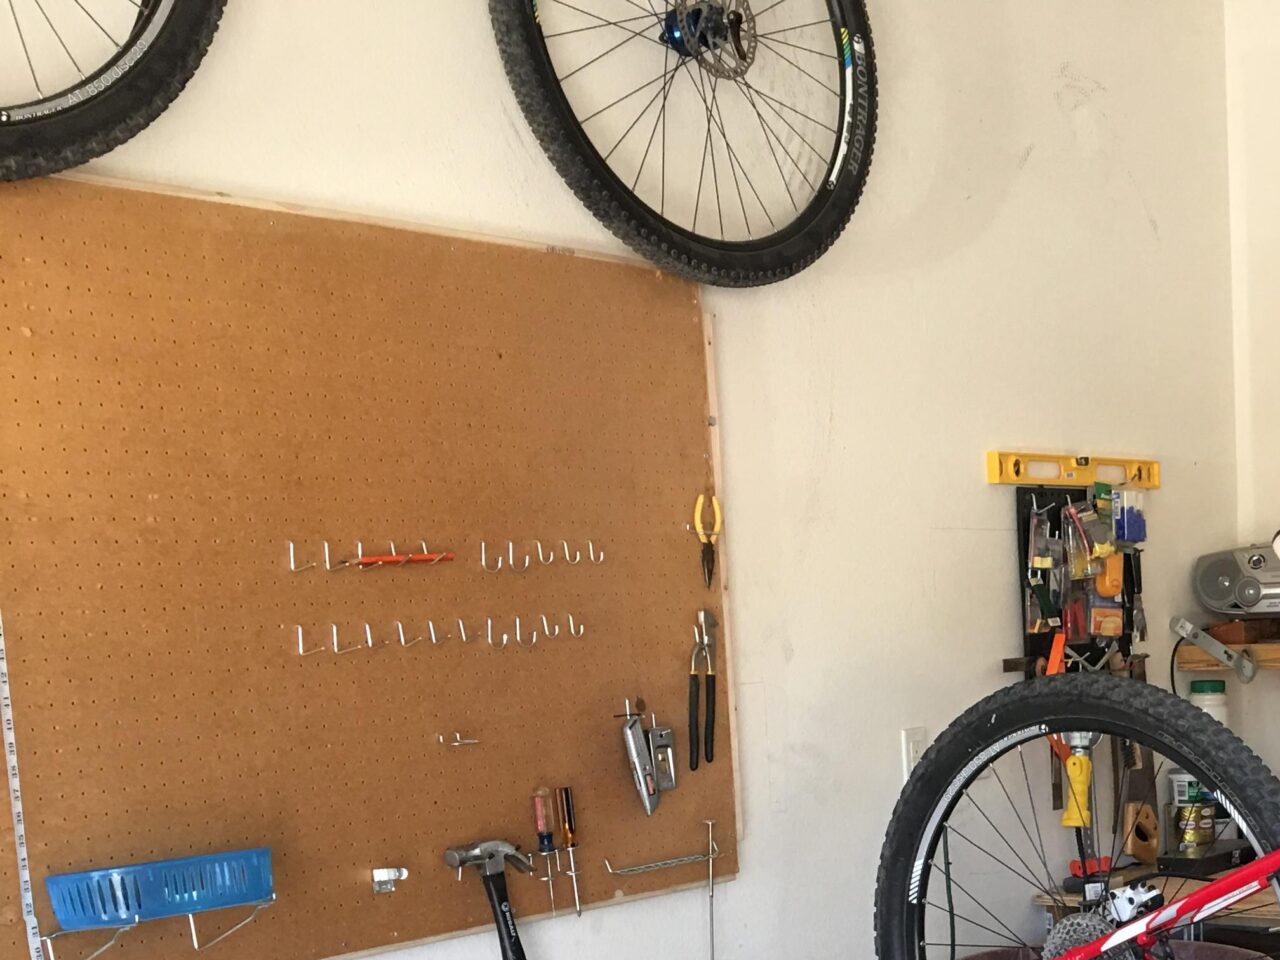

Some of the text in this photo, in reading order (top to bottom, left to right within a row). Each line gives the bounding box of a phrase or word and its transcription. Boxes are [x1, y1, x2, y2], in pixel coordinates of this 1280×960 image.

[67, 89, 83, 106] AT
[86, 74, 112, 96] 850
[847, 53, 868, 176] BONTRAGER
